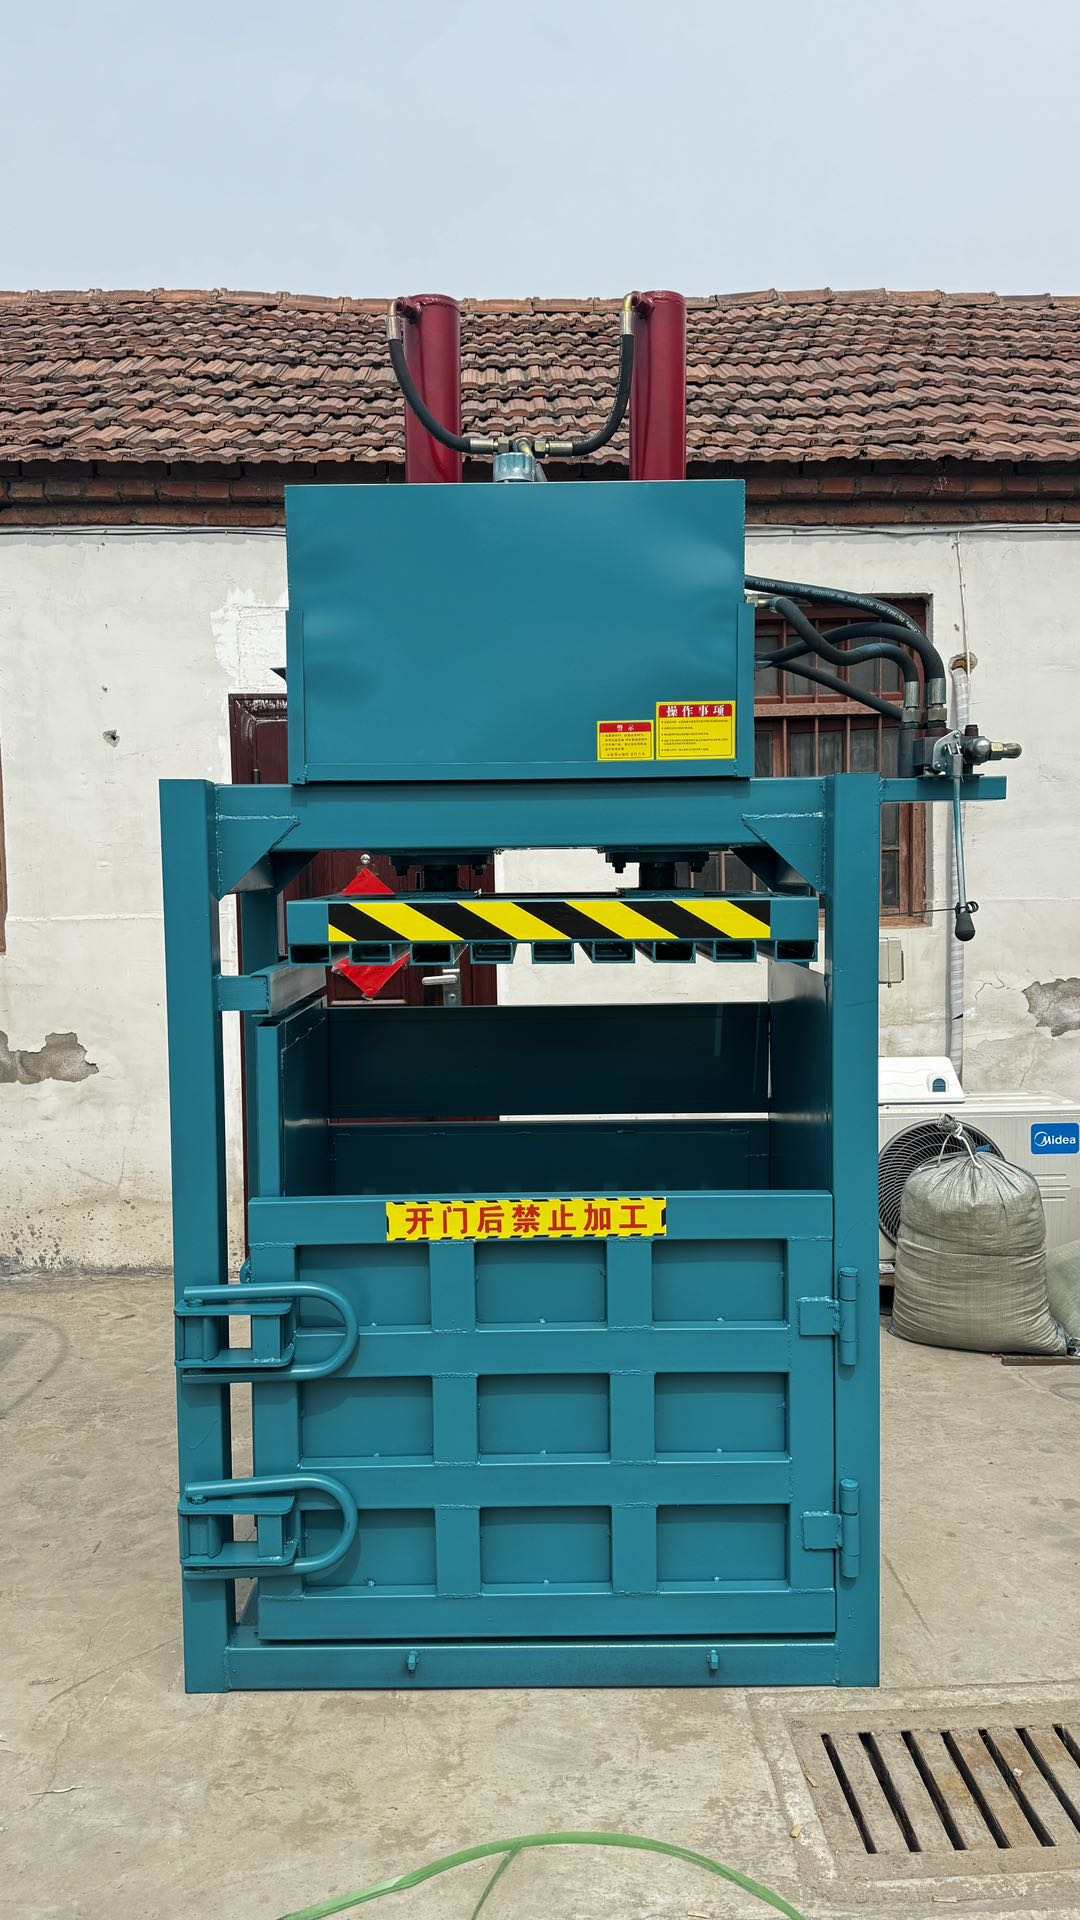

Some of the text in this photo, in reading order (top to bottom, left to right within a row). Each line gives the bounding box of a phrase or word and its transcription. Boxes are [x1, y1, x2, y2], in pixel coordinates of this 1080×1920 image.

[666, 705, 725, 718] 操作事项
[1035, 1132, 1076, 1146] Midea
[405, 1203, 648, 1235] 开门后禁止加工
